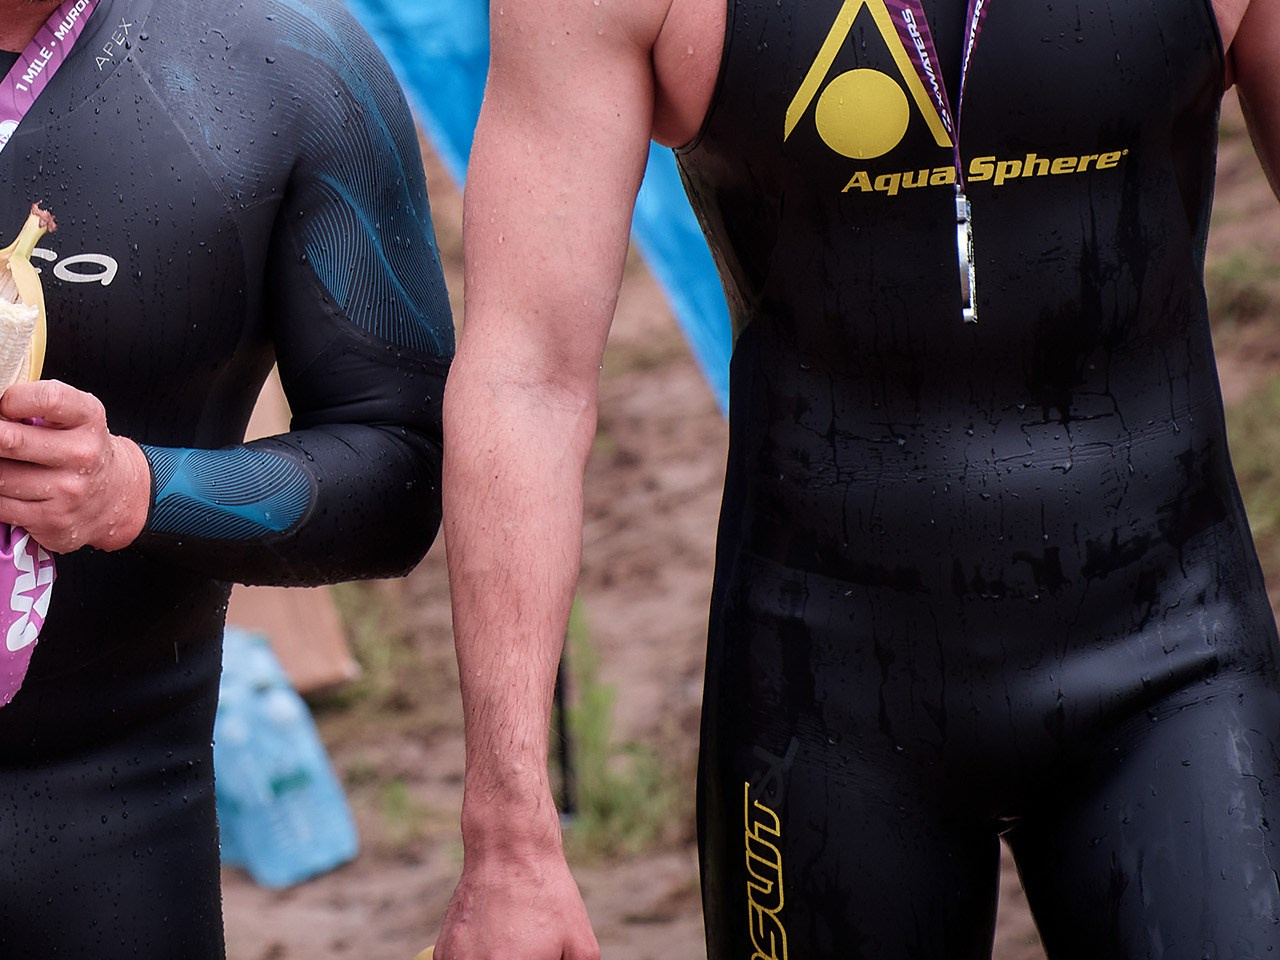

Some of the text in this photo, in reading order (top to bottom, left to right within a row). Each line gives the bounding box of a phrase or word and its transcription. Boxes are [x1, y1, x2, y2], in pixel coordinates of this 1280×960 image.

[15, 83, 28, 92] 1
[22, 46, 54, 84] MILE
[94, 17, 133, 71] APEX
[841, 165, 957, 197] Aqua
[743, 780, 789, 960] SUIT
